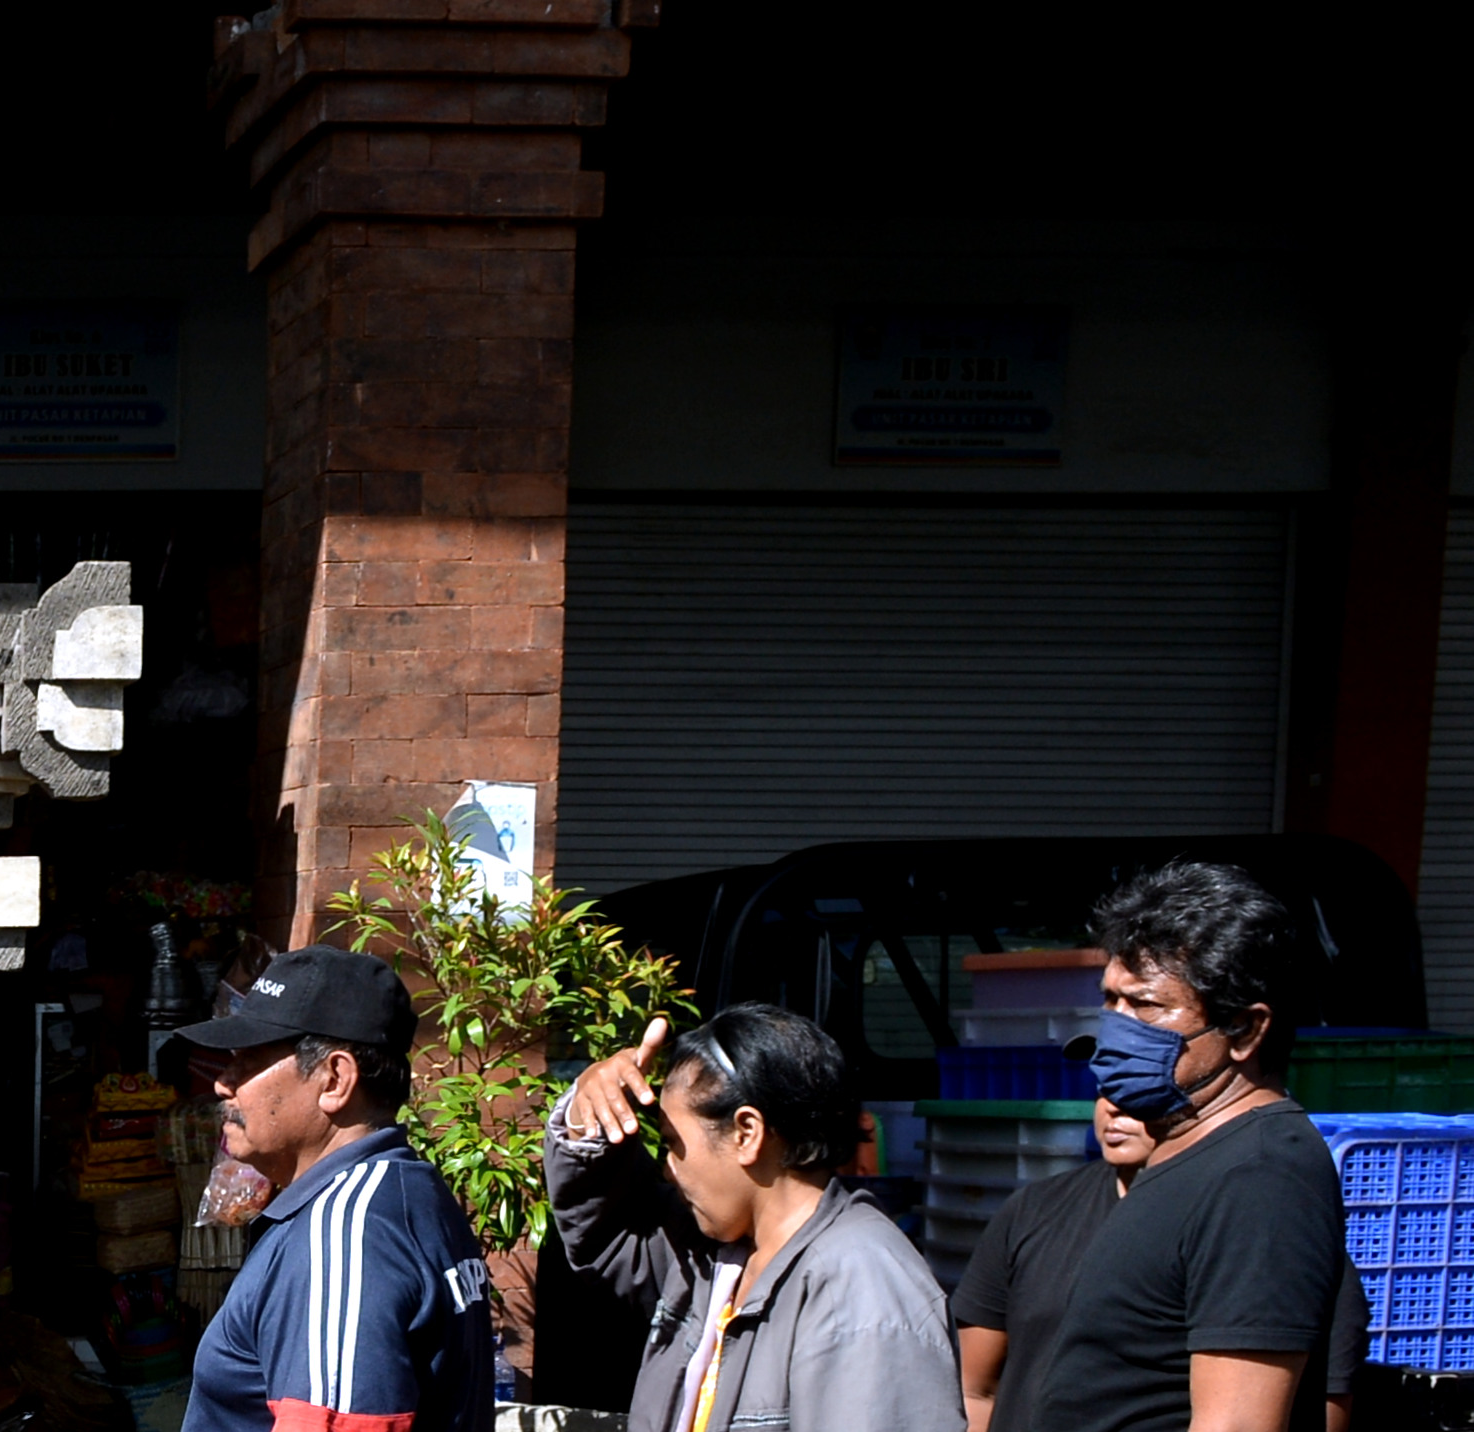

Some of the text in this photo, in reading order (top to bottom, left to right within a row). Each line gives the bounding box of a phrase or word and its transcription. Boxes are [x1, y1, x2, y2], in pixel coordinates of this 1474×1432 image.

[4, 354, 134, 378] IBU SUKET
[901, 357, 1009, 381] IBU SRI
[21, 408, 69, 422] PASAR
[73, 408, 147, 422] KETAPIAN
